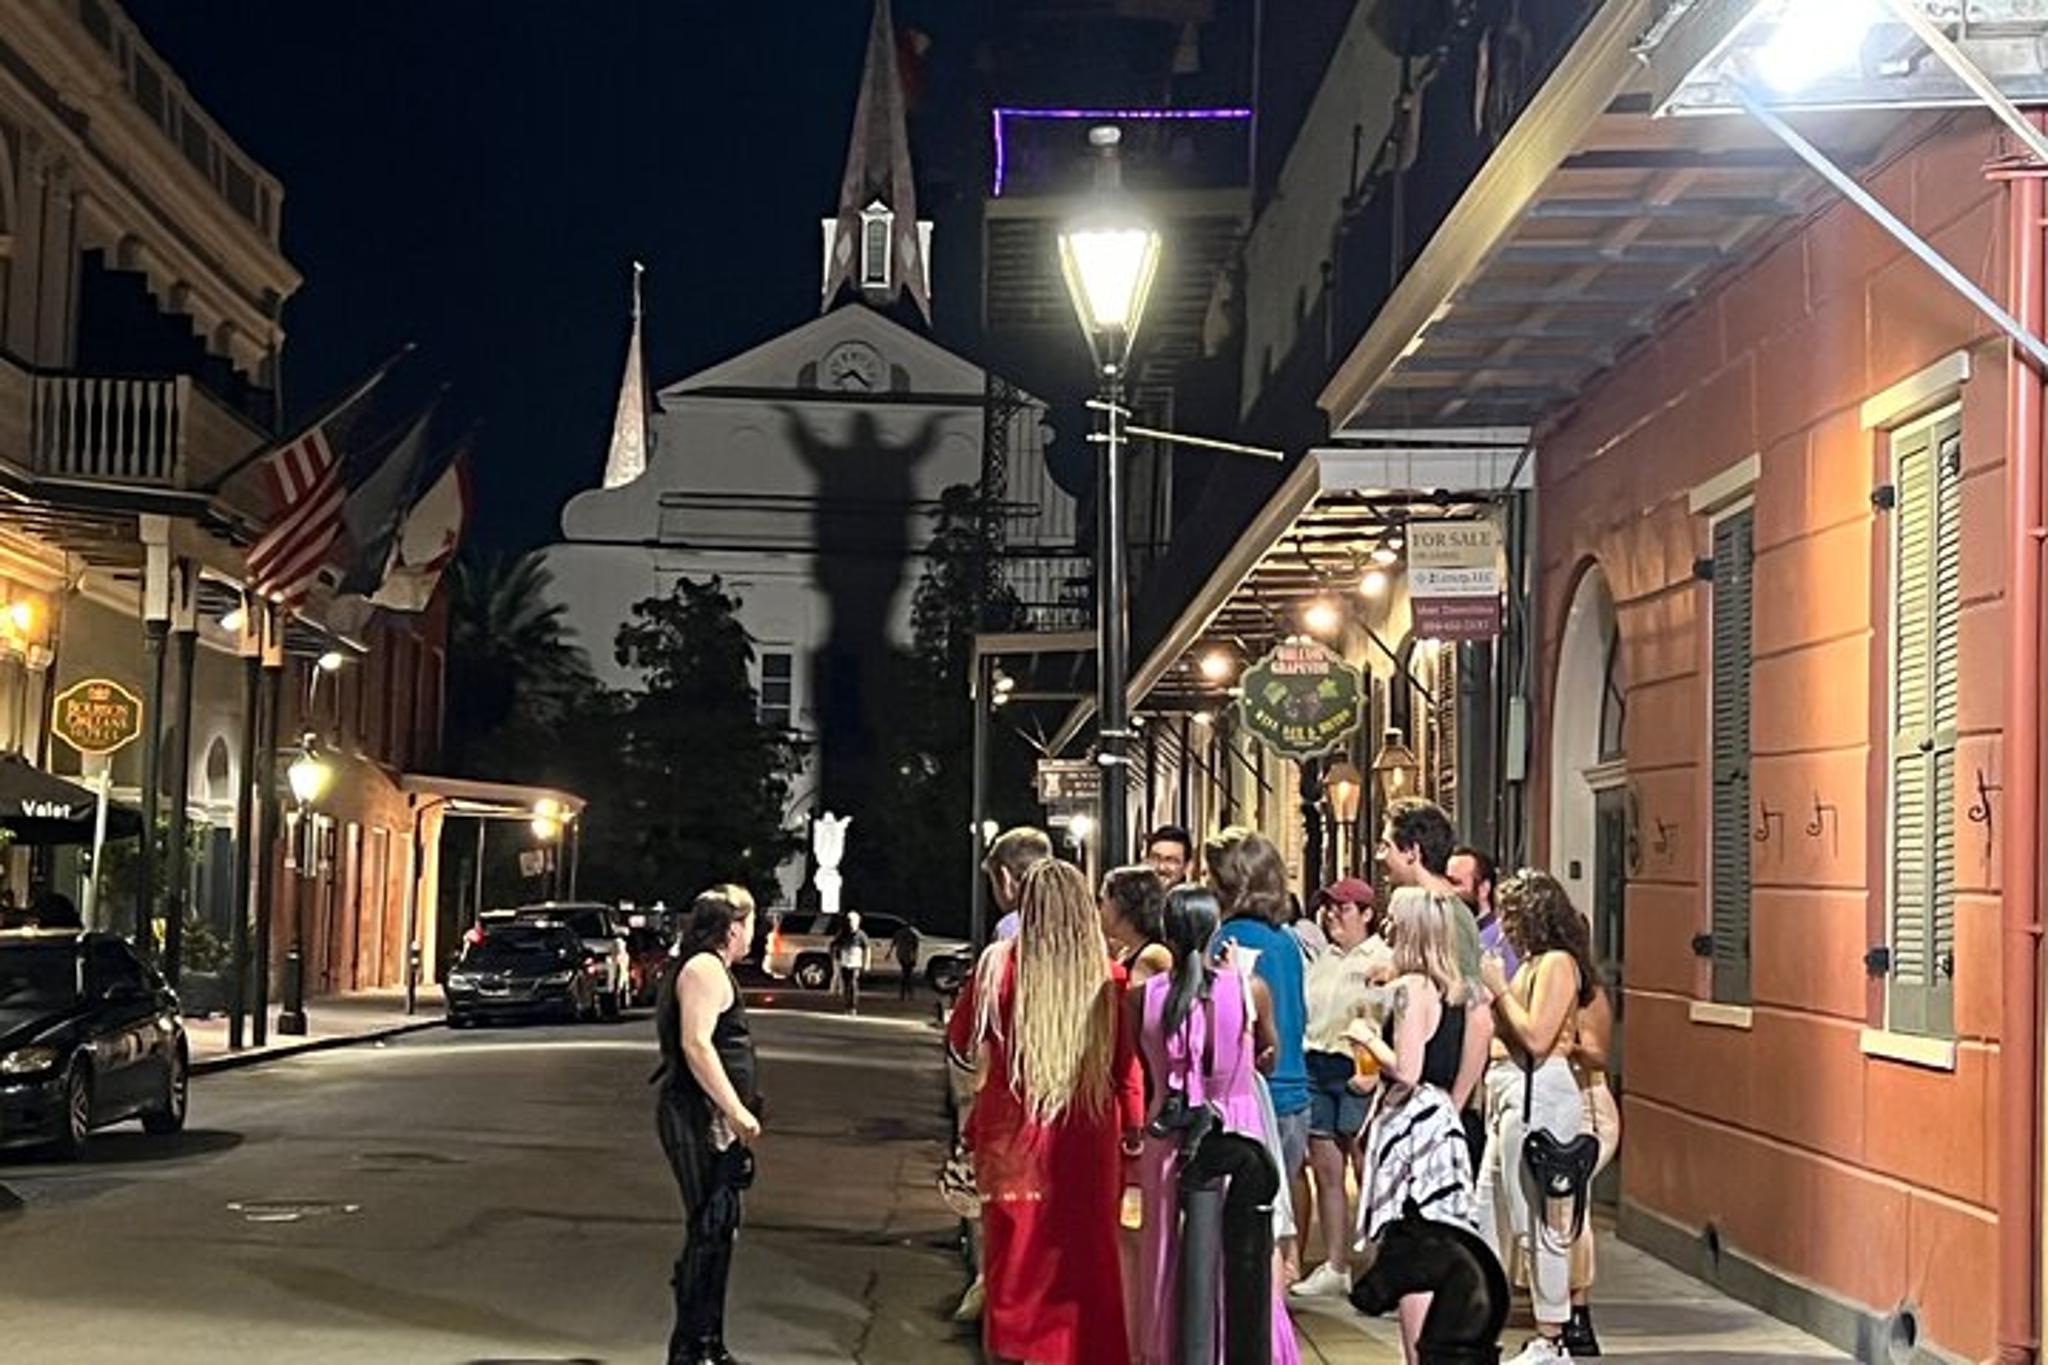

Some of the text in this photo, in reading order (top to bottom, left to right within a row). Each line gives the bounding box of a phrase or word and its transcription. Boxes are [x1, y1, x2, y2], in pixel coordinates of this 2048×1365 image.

[1412, 529, 1492, 547] FOR SALE
[67, 698, 128, 716] BOURBON
[21, 799, 71, 819] Valet
